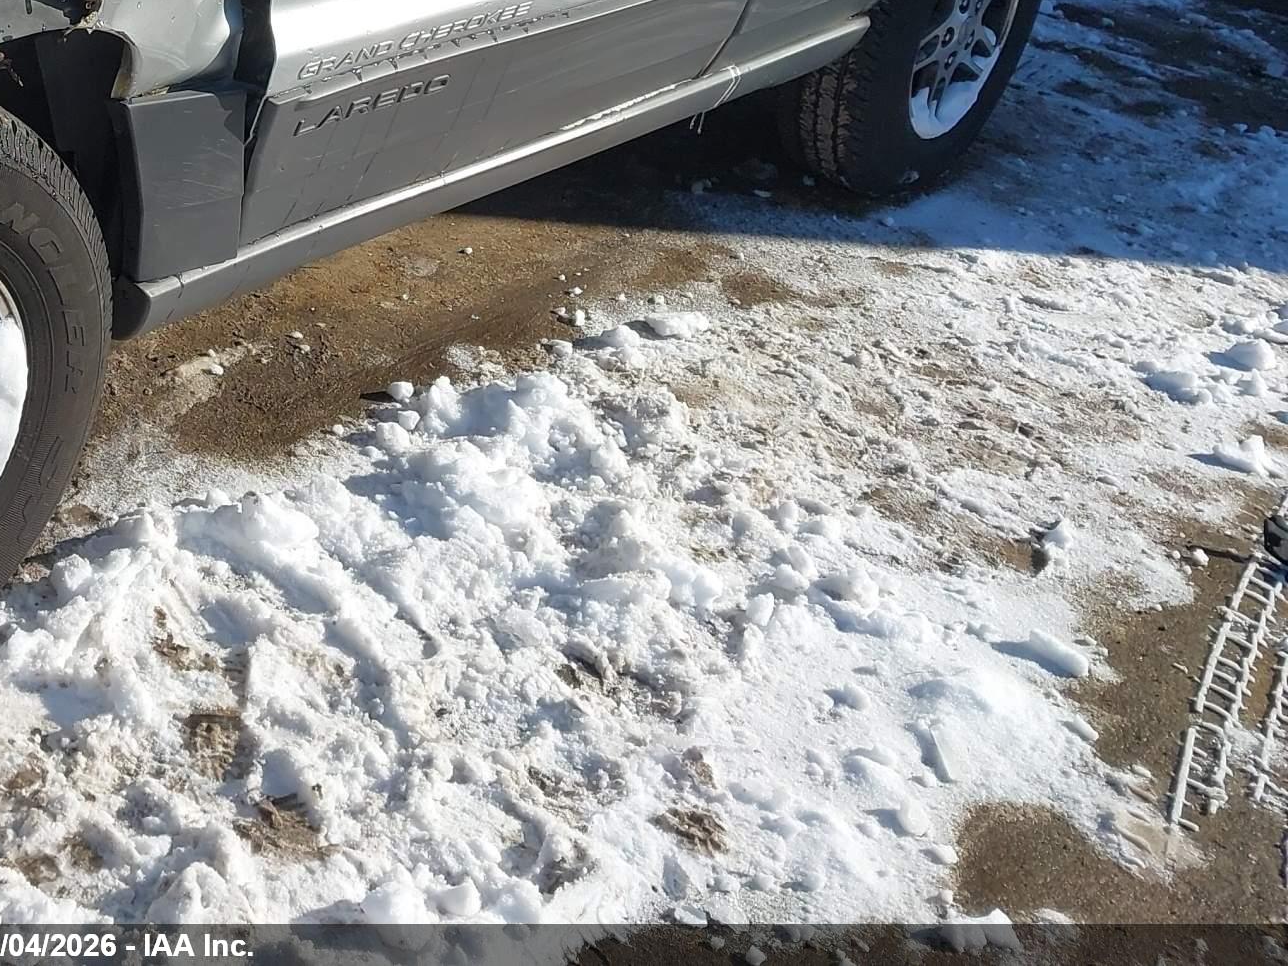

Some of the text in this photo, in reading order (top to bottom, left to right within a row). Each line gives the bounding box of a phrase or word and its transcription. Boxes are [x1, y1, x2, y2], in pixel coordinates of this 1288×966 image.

[297, 0, 534, 81] GRAND CHEROKEE
[292, 73, 452, 138] LAREDO
